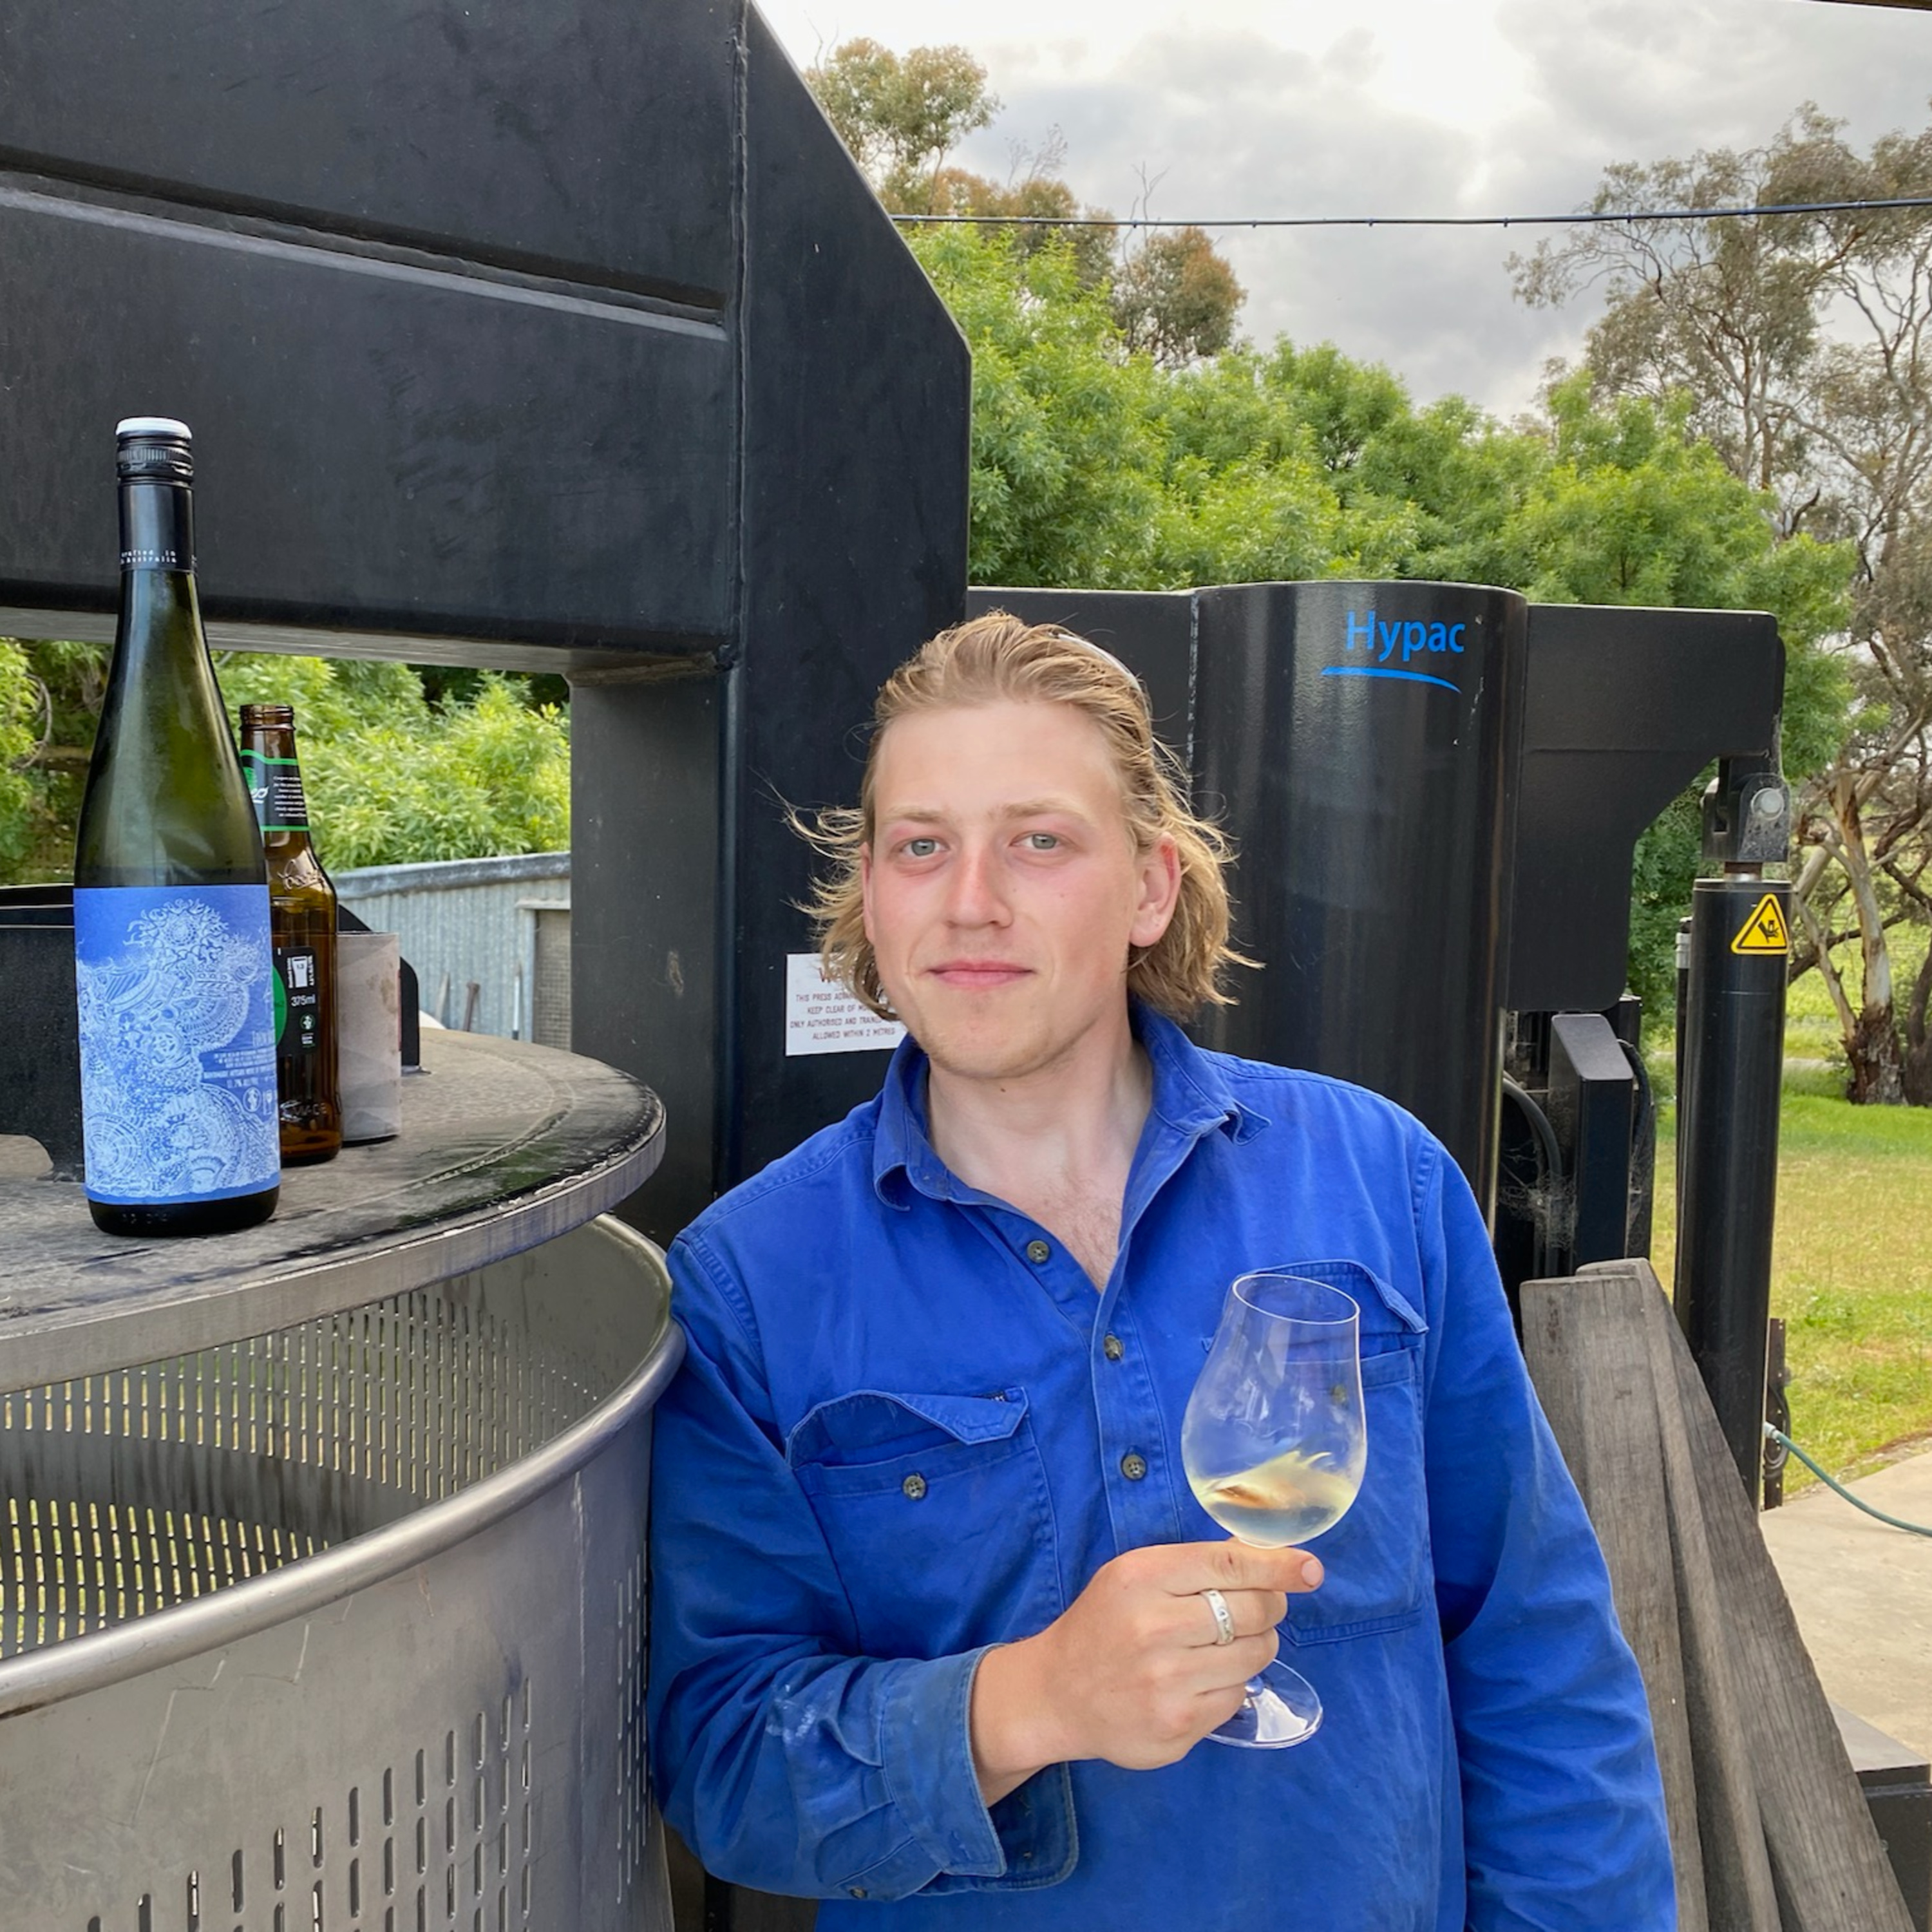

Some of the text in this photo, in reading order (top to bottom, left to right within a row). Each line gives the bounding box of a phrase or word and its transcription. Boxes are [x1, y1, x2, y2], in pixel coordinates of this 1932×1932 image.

[1346, 610, 1466, 663] Hypac
[290, 994, 316, 1007] 375ml
[796, 994, 810, 1002] THIS
[812, 993, 832, 1001] PRESS
[808, 1005, 823, 1014] KEEP
[825, 1005, 845, 1014] CLEAR
[847, 1004, 856, 1012] OF
[790, 1020, 805, 1028] ONLY
[844, 1017, 857, 1025] AND
[812, 1027, 896, 1040] ALLOWED WITHIN 2 METRES
